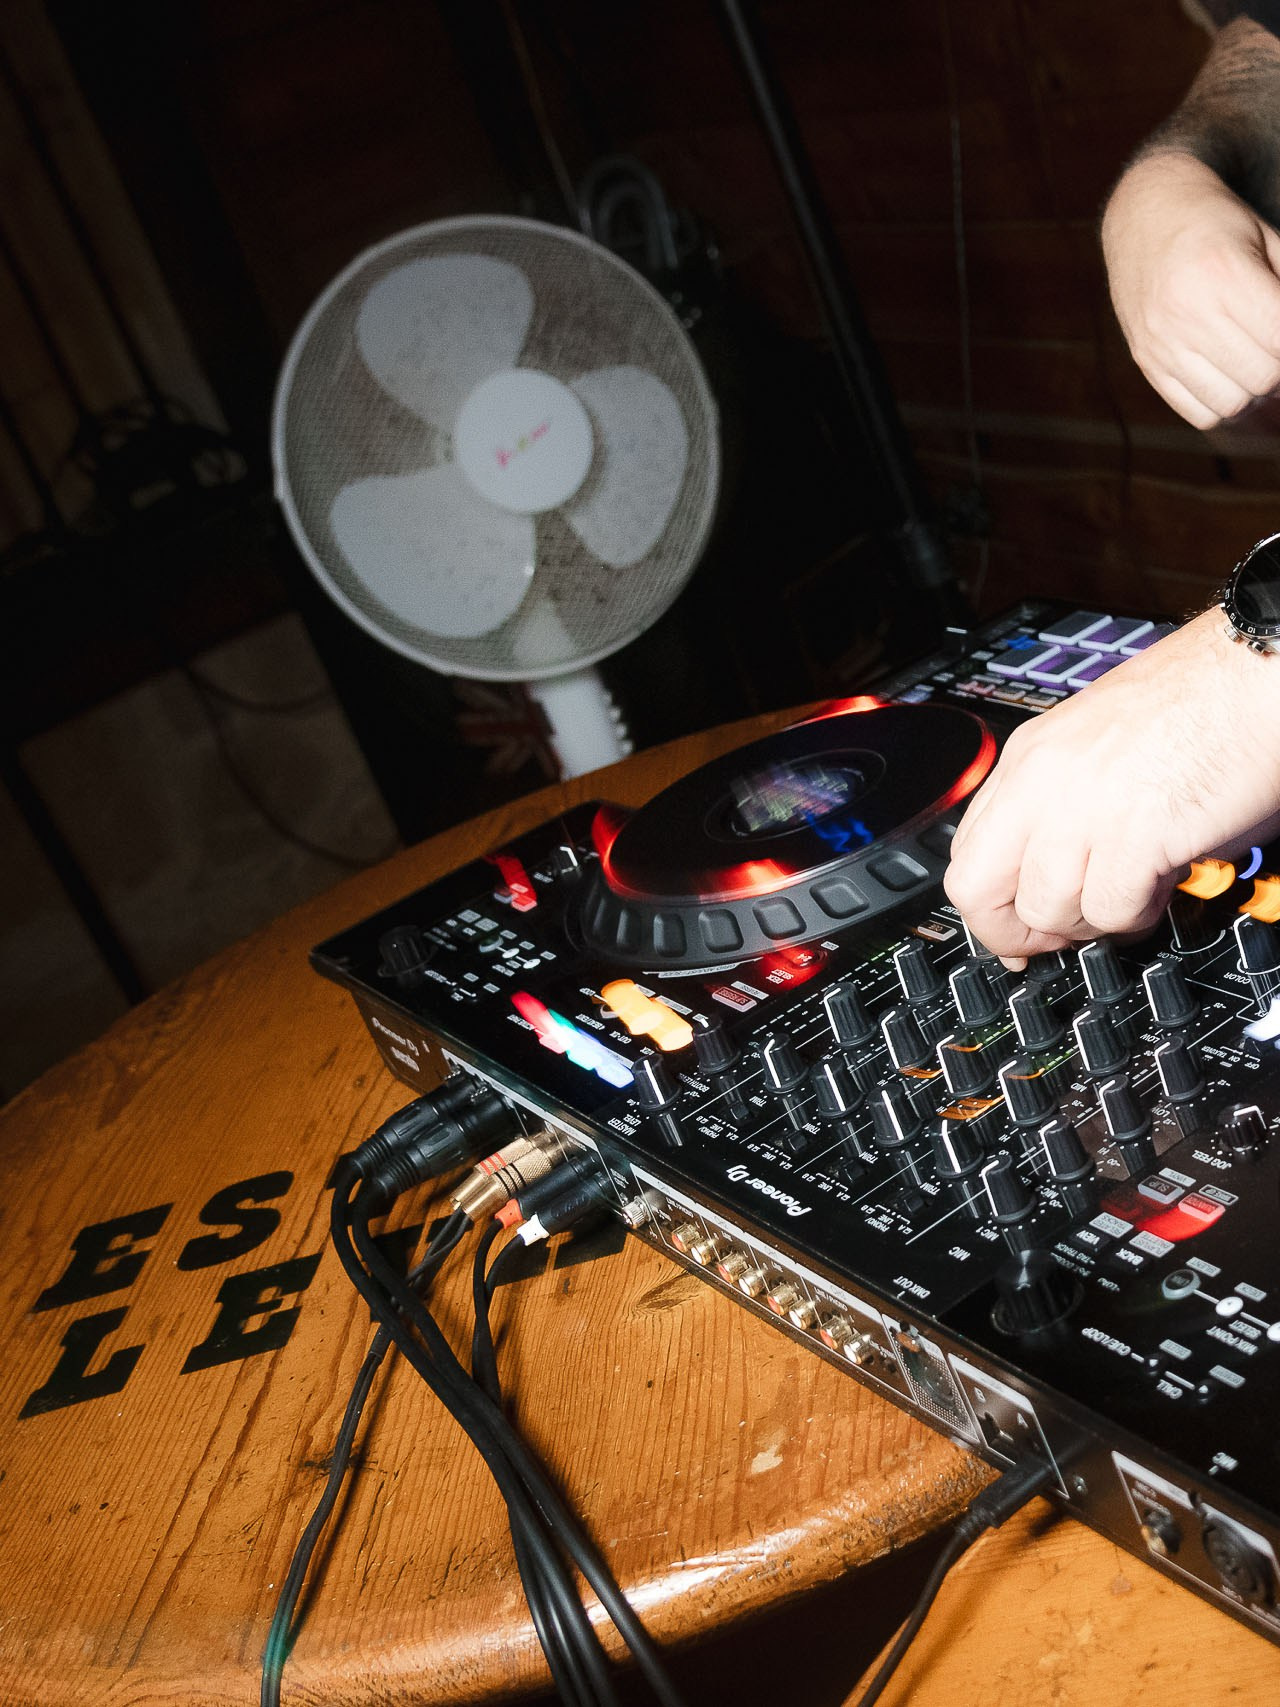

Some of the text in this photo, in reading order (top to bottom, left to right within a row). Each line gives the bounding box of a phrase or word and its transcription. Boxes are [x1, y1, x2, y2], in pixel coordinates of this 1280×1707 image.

[766, 974, 784, 984] DECK
[771, 968, 795, 980] SELECT
[1223, 972, 1251, 984] COLOR
[1140, 1033, 1160, 1043] LOW
[1228, 1055, 1241, 1063] ON
[1244, 1062, 1260, 1070] OFF
[687, 1078, 711, 1093] BOOTH
[1070, 1082, 1087, 1092] MID
[748, 1096, 768, 1108] TRIM
[1151, 1106, 1171, 1117] LOW
[622, 1114, 642, 1126] LEVEL
[607, 1117, 637, 1136] MASTER
[708, 1122, 724, 1133] LINE
[801, 1122, 821, 1135] TRIM
[761, 1151, 776, 1161] LINE
[1097, 1146, 1110, 1155] HI
[859, 1151, 879, 1165] TRIM
[1191, 1149, 1232, 1170] JOG FEEL
[818, 1181, 833, 1192] LINE
[919, 1182, 940, 1196] TRIM
[1149, 1180, 1170, 1192] SLIP
[744, 1176, 812, 1217] Pioneer
[1040, 1187, 1060, 1199] MIC
[877, 1213, 894, 1225] LINE
[981, 1228, 1000, 1241] MIC
[1076, 1230, 1101, 1245] VIEW
[948, 1246, 971, 1261] MIC
[1115, 1248, 1144, 1266] BACK
[892, 1274, 931, 1299] DMX OUT
[1081, 1327, 1132, 1356] CUE/LOOP
[1205, 1326, 1258, 1355] MIX POINT
[1156, 1380, 1184, 1400] CALL
